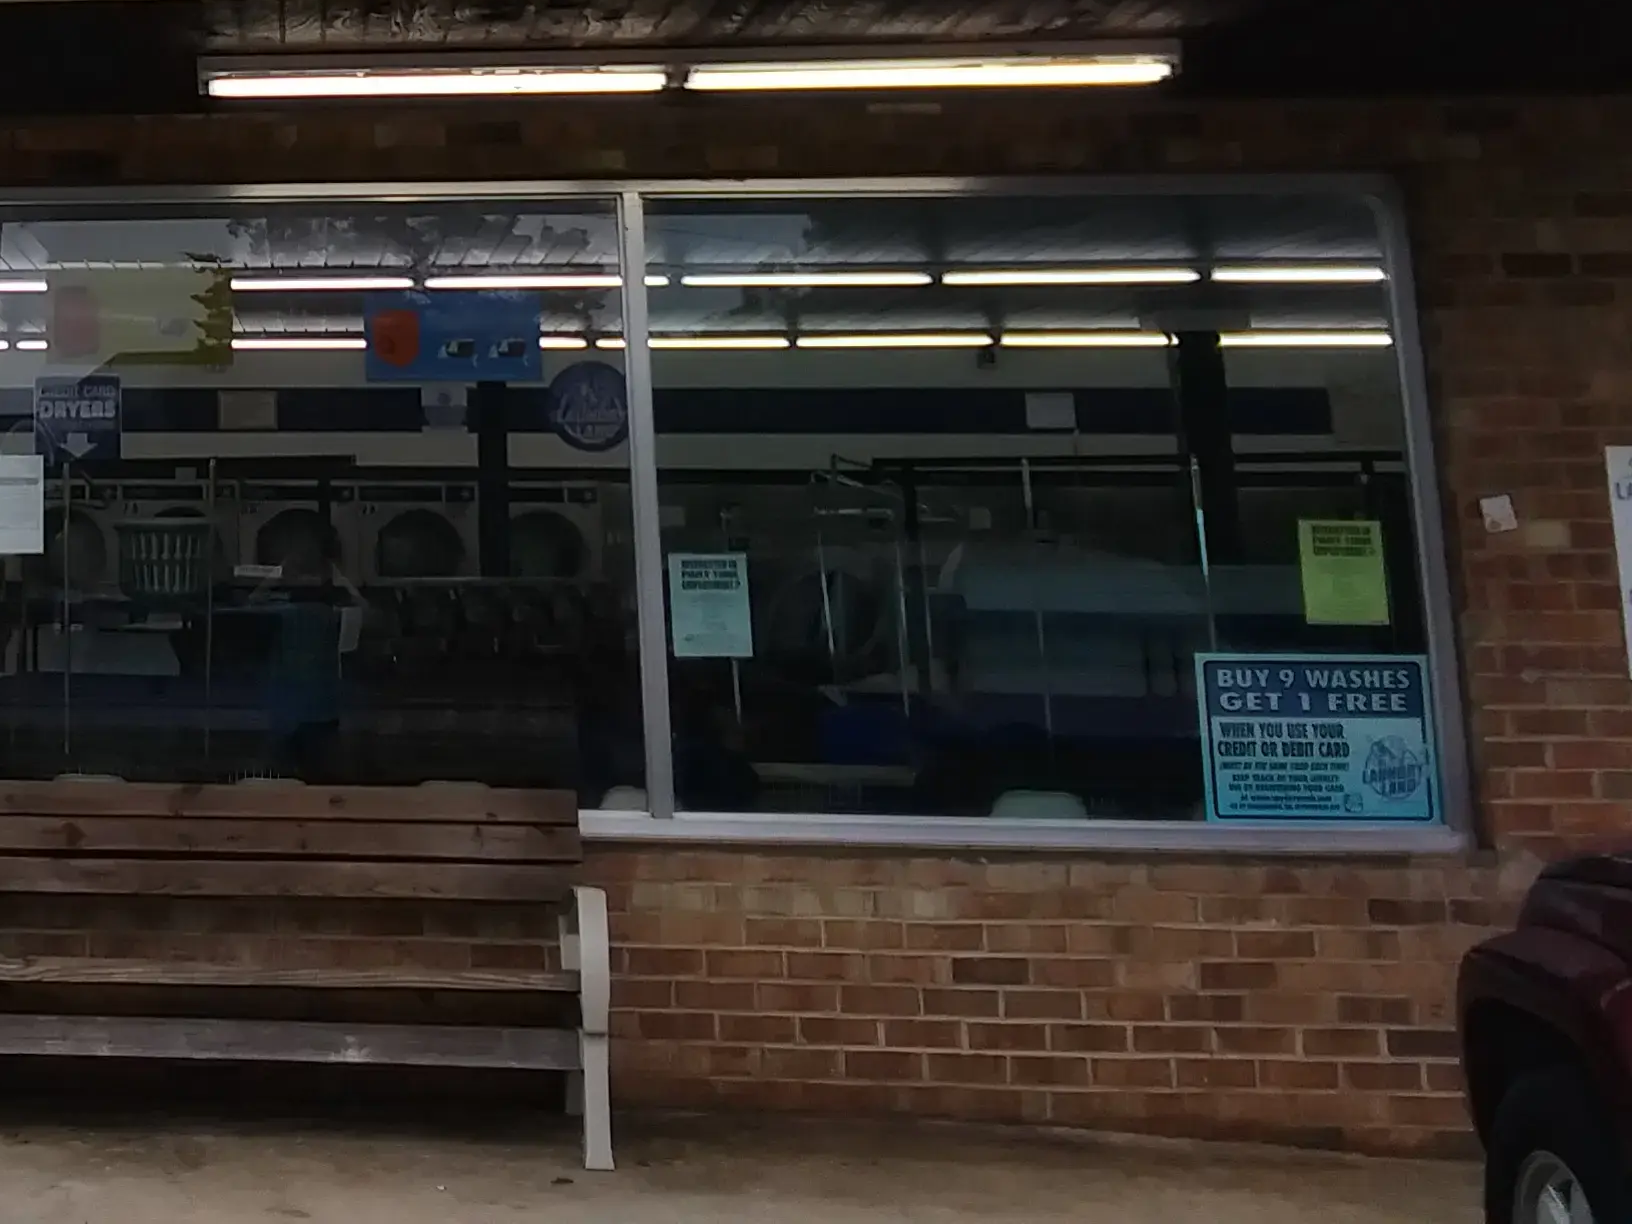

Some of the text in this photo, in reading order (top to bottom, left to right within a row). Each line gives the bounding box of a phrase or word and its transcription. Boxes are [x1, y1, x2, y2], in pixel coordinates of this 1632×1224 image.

[40, 400, 116, 419] DRYERS
[1218, 669, 1411, 689] BUY 9 WASHES
[1219, 692, 1408, 712] GET 1 FREE
[1219, 722, 1345, 739] WHEN YOU USE YOUR
[1218, 741, 1350, 758] CREDIT OR DEBIT CARD
[1382, 778, 1417, 797] LAND
